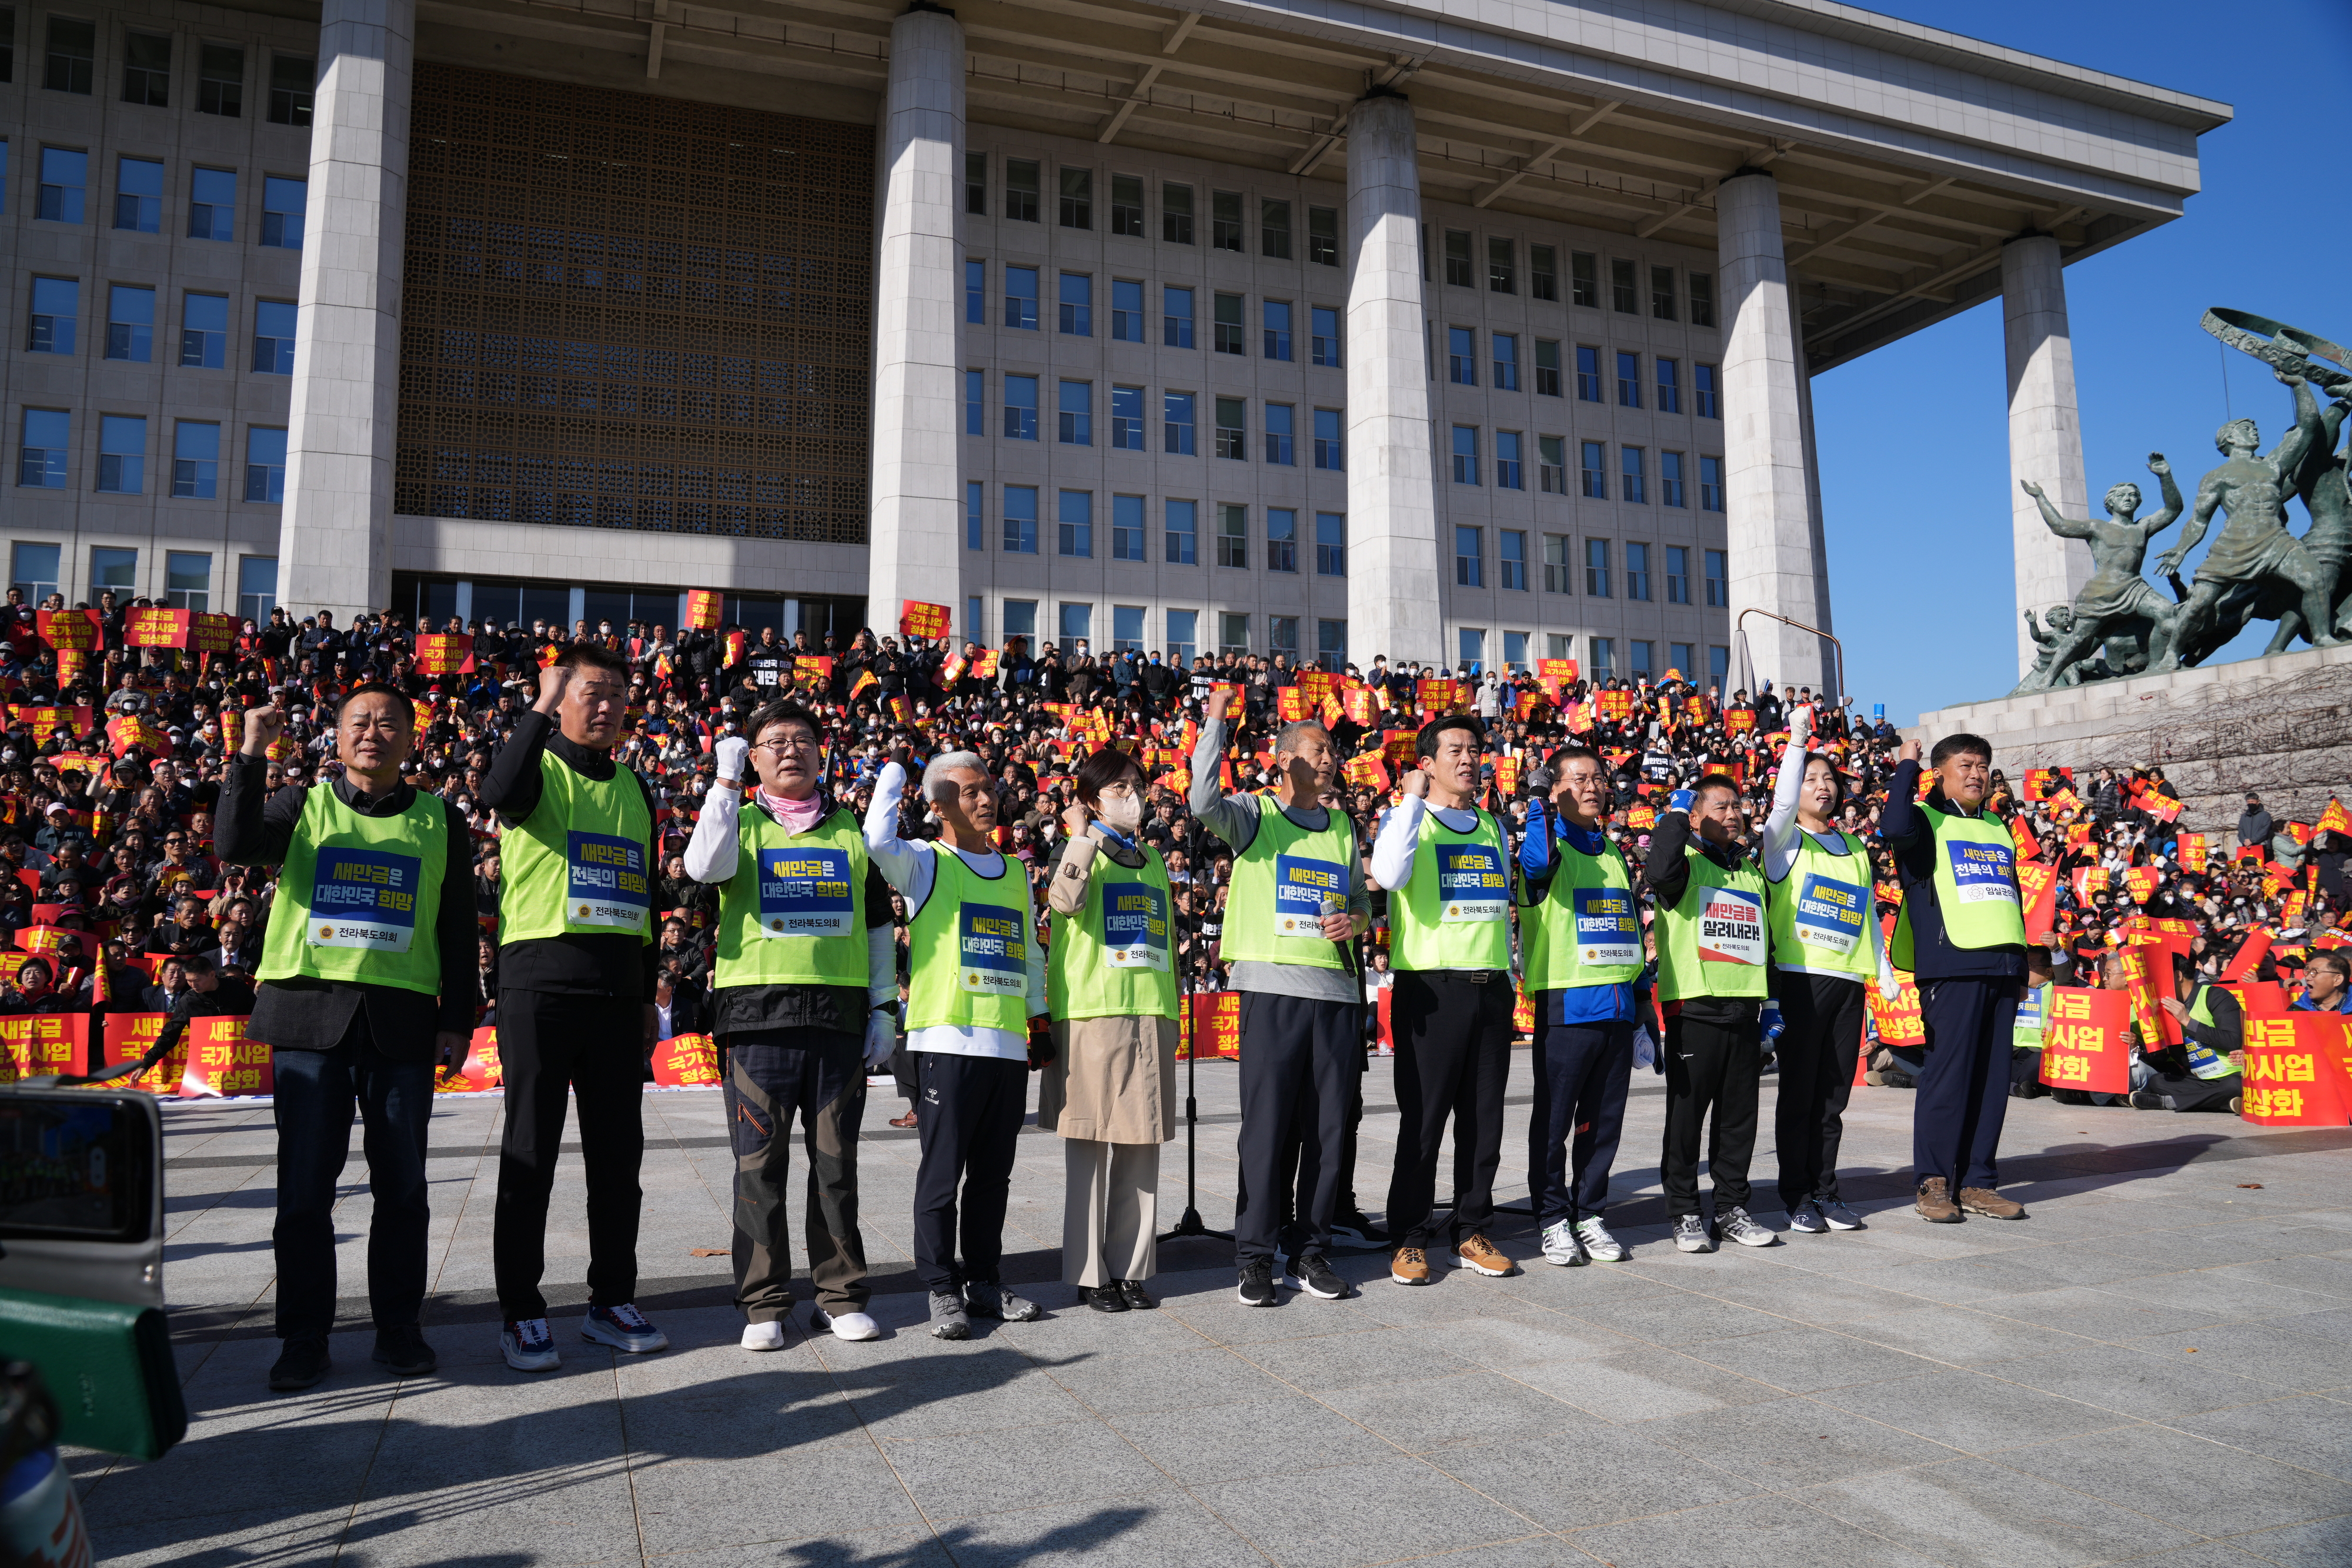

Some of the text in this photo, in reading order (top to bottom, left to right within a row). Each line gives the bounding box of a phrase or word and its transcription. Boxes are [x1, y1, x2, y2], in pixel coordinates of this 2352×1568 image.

[697, 593, 717, 604] 새만금
[141, 610, 173, 621] 새만금
[692, 604, 719, 616] 국가사업
[914, 603, 940, 617] 새만금
[52, 612, 85, 623] 새만금
[198, 616, 228, 627] 새만금
[693, 615, 715, 627] 정상화
[908, 614, 943, 627] 국가사업
[46, 624, 92, 636] 국가사업
[135, 623, 178, 633] 국가사업
[193, 627, 233, 639] 국가사업
[910, 626, 937, 637] 정상화
[53, 637, 88, 649] 정상화
[139, 634, 172, 644] 정상화
[429, 637, 459, 647] 새만금
[198, 640, 229, 651] 정상화
[424, 648, 464, 659] 국가사업
[429, 661, 460, 671] 정상화
[749, 659, 792, 669] 대한민국 미래
[753, 670, 779, 685] 새만
[1306, 673, 1329, 683] 새만금
[1544, 668, 1572, 676] 국가사업
[1302, 683, 1332, 692] 국가사업
[1426, 681, 1447, 690] 새만금
[1532, 678, 1547, 687] 만금
[1286, 689, 1305, 698] 새만금
[1355, 691, 1375, 702] 새만금
[1422, 691, 1450, 700] 국가사업
[1524, 694, 1542, 703] 새만금
[1605, 692, 1625, 701] 새만금
[1283, 698, 1309, 708] 국가사업
[1350, 701, 1377, 713] 국가사업
[1426, 701, 1447, 710] 정상화
[1578, 703, 1591, 714] 새만
[1601, 701, 1629, 710] 국가사업
[36, 709, 74, 722] 새만금
[1046, 705, 1070, 716] 새만금
[1227, 707, 1240, 716] 상화
[1287, 709, 1307, 719] 정상화
[1730, 711, 1748, 720] 새만금
[1354, 711, 1374, 723] 정상화
[34, 723, 81, 735] 국가업
[1729, 720, 1752, 728] 국가사업
[122, 735, 159, 750] 정상화
[1395, 733, 1417, 741] 새만금
[1066, 743, 1093, 753] 새금
[1499, 770, 1515, 780] 국가
[1711, 766, 1733, 774] 새만금
[1920, 770, 1933, 782] 새만
[1628, 809, 1655, 823] 새만금
[581, 843, 639, 870] 새만금은
[1963, 848, 2009, 863] 새만금은
[2185, 848, 2205, 859] 국가
[1449, 855, 1494, 870] 새만금은
[333, 862, 403, 887] 새만금은
[773, 860, 835, 878] 새만금은
[1955, 863, 1994, 878] 전북의
[2087, 869, 2109, 880] 새만
[572, 865, 647, 894] 전북의 희망!
[1289, 867, 1338, 889] 새만금은
[1441, 872, 1505, 888] 대한민국 희망
[762, 881, 848, 898] 대한민국 희망
[1278, 885, 1321, 904] 대한민국
[315, 884, 413, 912] 대한민국 희망
[1812, 885, 1856, 908] 새만금은
[2291, 891, 2306, 903] 새만
[1117, 895, 1158, 915] 새만금은
[1462, 906, 1501, 914] 전라북도의회
[1586, 899, 1628, 914] 새만금은
[596, 907, 639, 922] 전라북도의회
[1705, 902, 1756, 922] 새만금을
[1799, 898, 1863, 926] 대한민국 희망
[788, 918, 840, 928] 전라북도의회
[972, 917, 1019, 938] 새만금은
[1107, 914, 1166, 936] 대한민국 희망
[1578, 917, 1636, 932] 대한민국 희망
[2159, 920, 2188, 933] 새만금
[339, 927, 397, 944] 전라북도의회
[1703, 921, 1760, 941] 살려내라!
[1813, 932, 1849, 947] 전라북도의회
[962, 936, 1025, 961] 대한민국 희망
[1722, 943, 1750, 951] 전라북도의회
[1130, 950, 1160, 963] 전라북도의회
[2283, 948, 2306, 960] 새만
[2120, 952, 2148, 982] 만금
[983, 975, 1021, 989] 전라북도의회
[1217, 996, 1240, 1012] 새만
[2024, 1003, 2040, 1011] 희망
[2053, 993, 2091, 1020] 만금
[0, 1019, 62, 1040] 새만금
[1211, 1016, 1240, 1031] 국가
[1877, 1015, 1925, 1040] 정상화
[2138, 1014, 2165, 1044] 상화
[201, 1045, 270, 1065] 국가사업
[2196, 1048, 2213, 1059] 희망
[2044, 1052, 2090, 1082] 정상화
[207, 1069, 261, 1090] 정상화
[2243, 1088, 2304, 1116] 정상화
